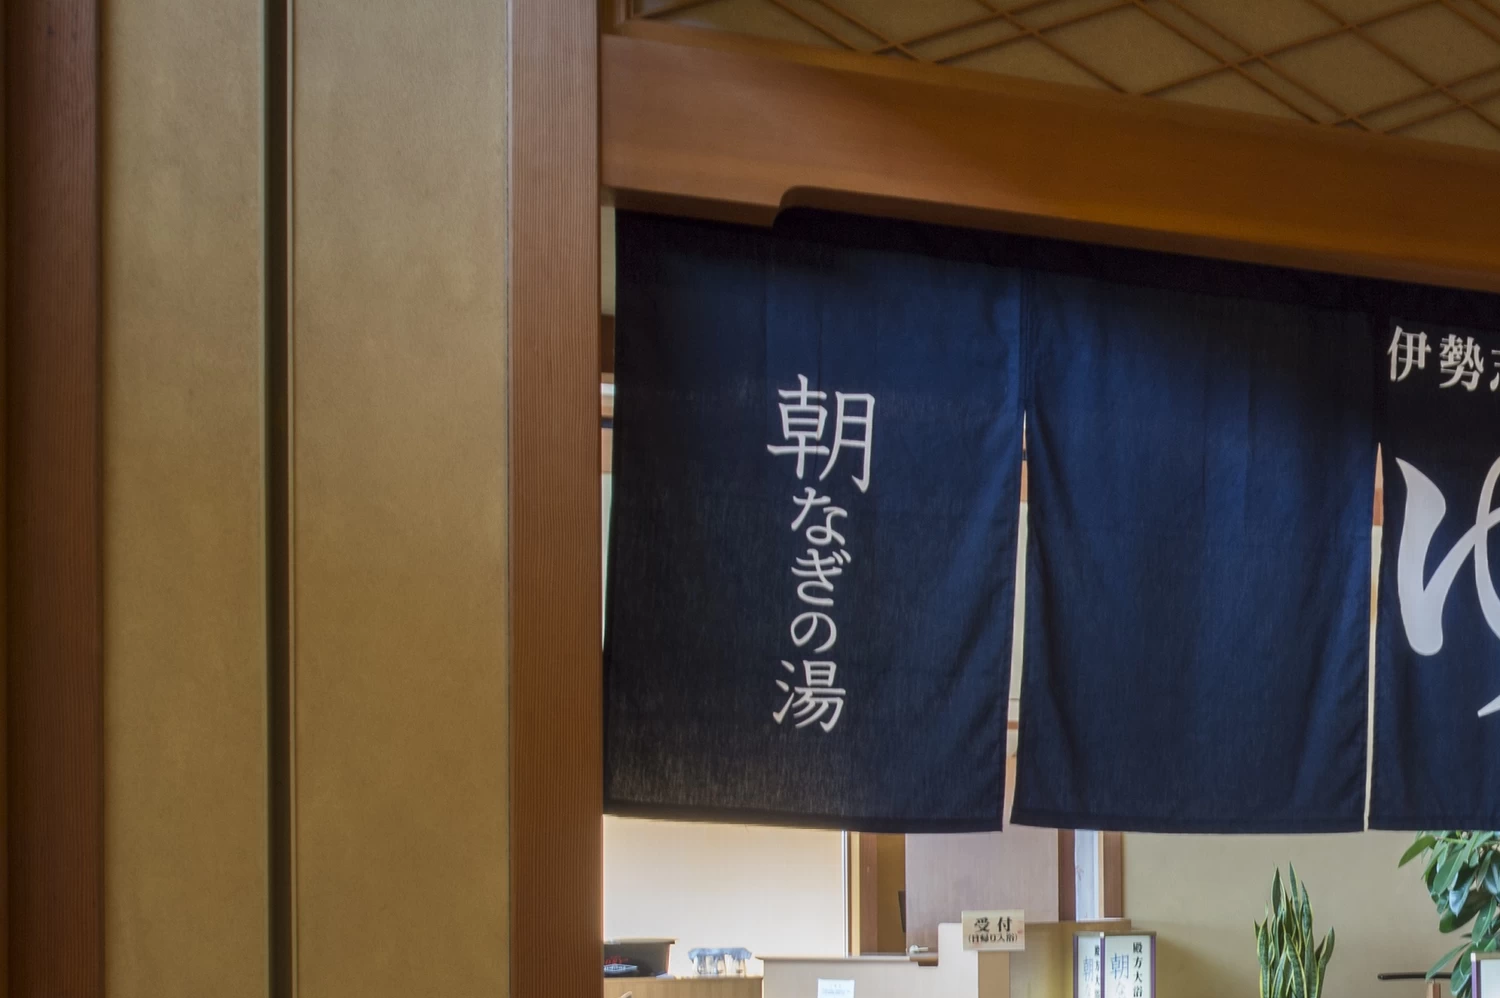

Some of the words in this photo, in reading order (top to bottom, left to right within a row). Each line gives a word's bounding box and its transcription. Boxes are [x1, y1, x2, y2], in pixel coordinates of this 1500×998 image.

[766, 373, 876, 733] 朝なぎの湯
[974, 916, 1012, 932] 受付
